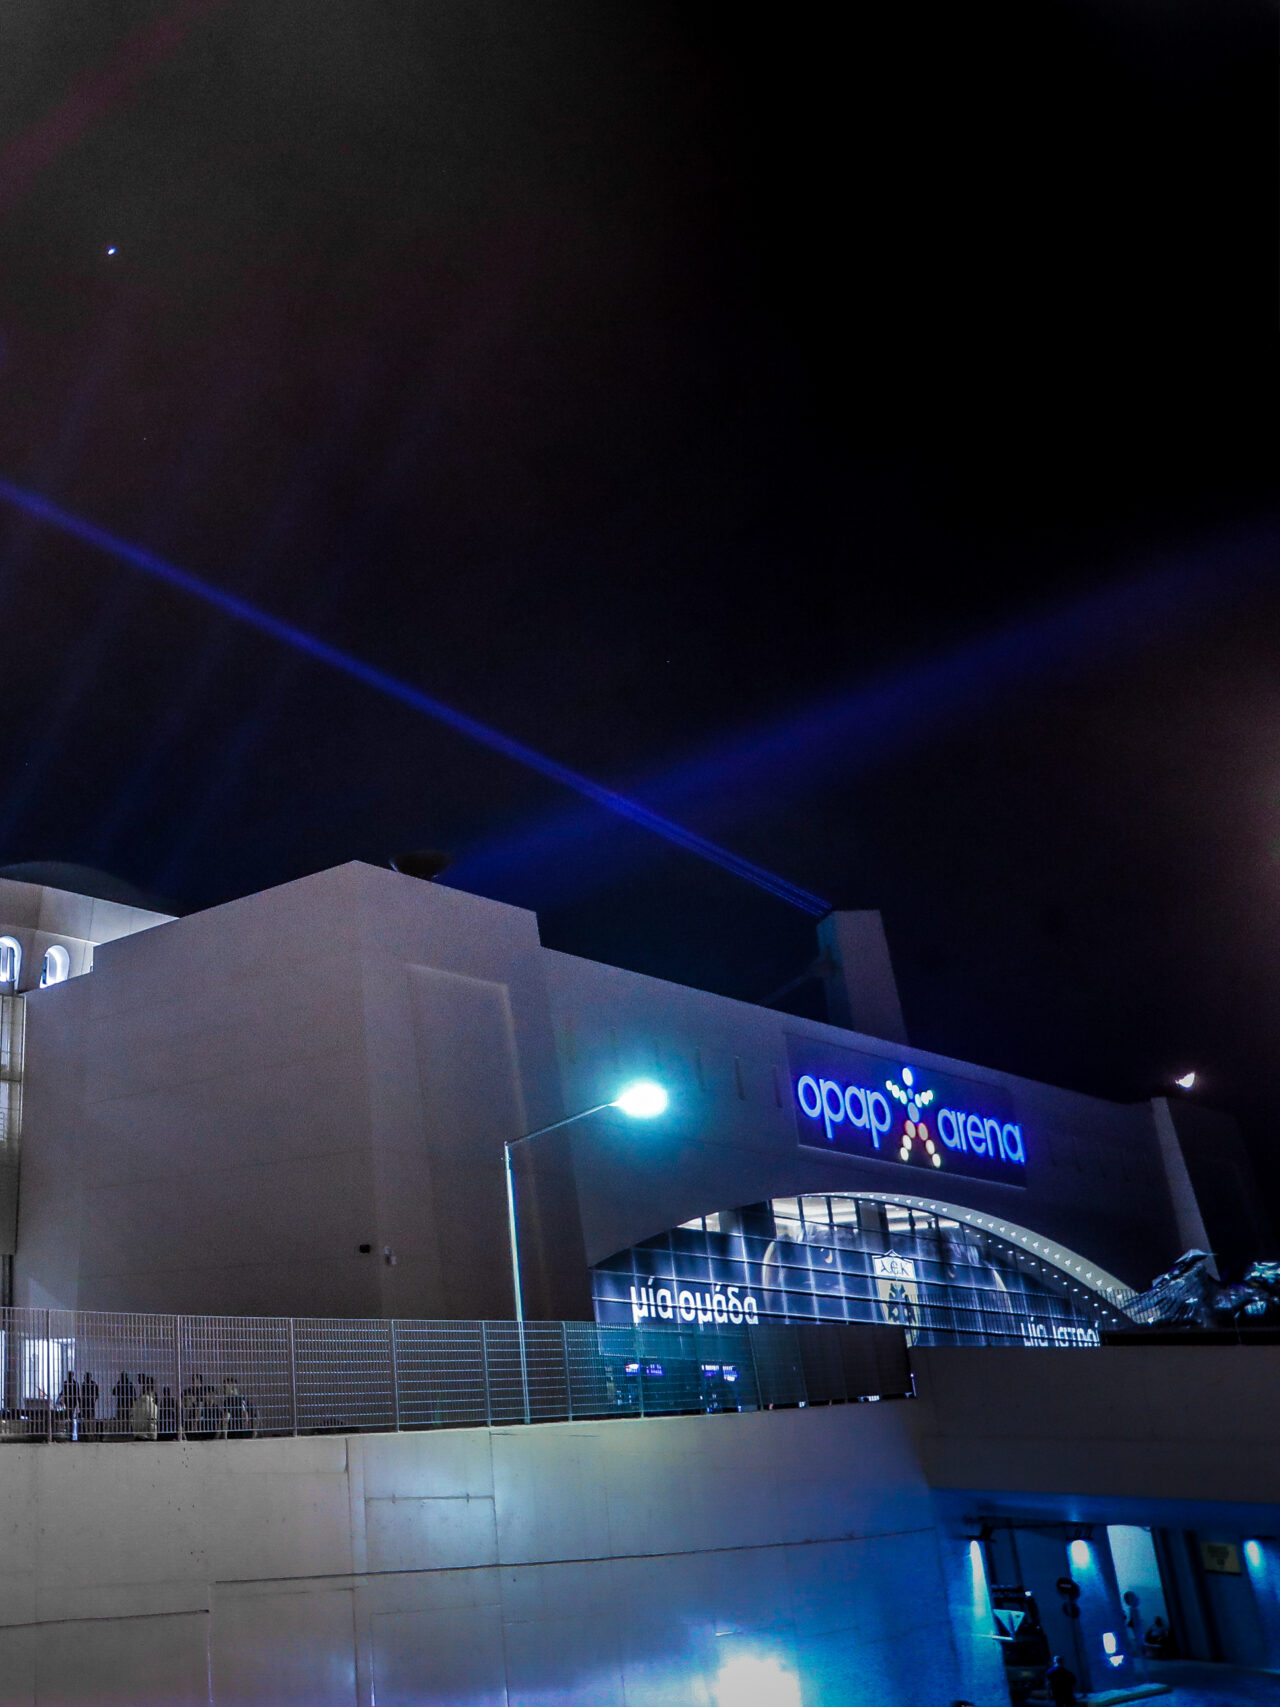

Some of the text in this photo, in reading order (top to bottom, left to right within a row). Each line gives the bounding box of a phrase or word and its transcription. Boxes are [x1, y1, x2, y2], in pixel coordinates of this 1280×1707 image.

[797, 1075, 1026, 1164] opap arena
[630, 1276, 759, 1329] μία ομάδα
